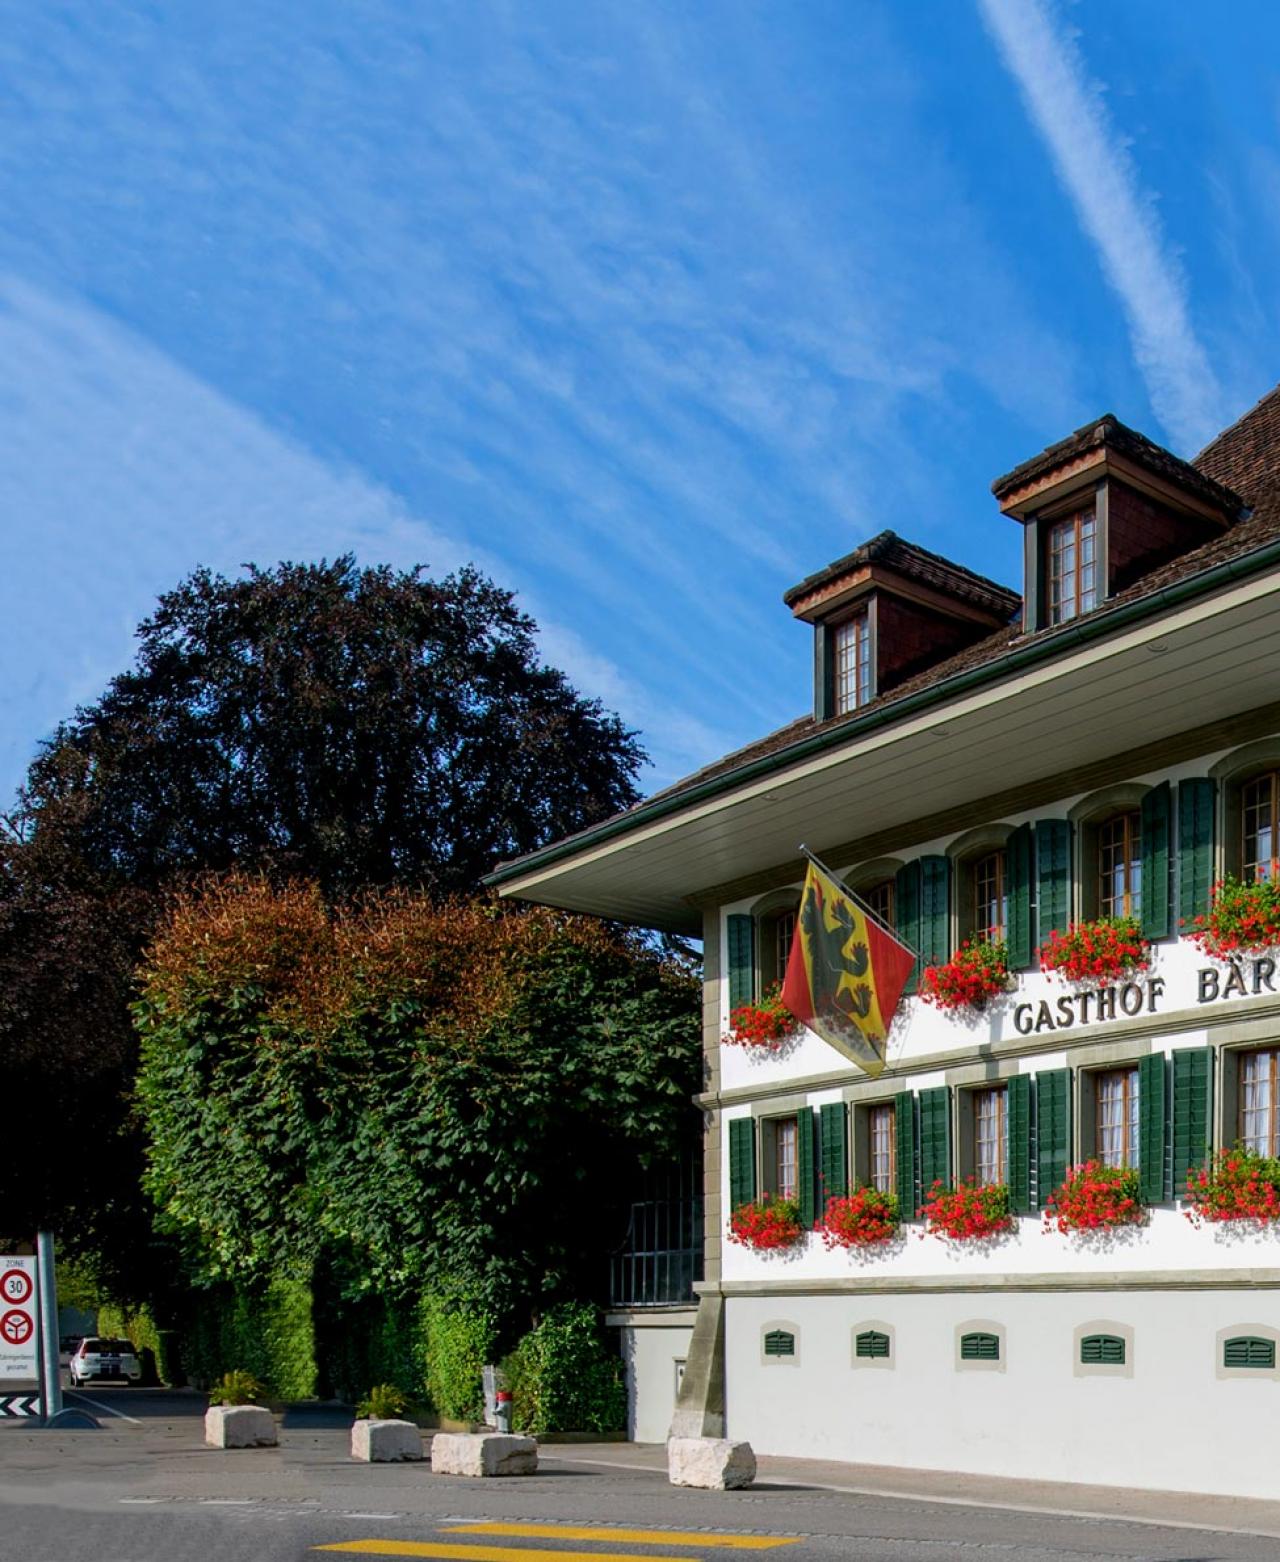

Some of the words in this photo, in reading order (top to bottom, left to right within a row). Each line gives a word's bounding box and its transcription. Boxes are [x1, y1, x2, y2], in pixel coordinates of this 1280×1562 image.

[1014, 977, 1166, 1035] GASTHOF
[6, 1259, 25, 1268] ZONE
[9, 1280, 23, 1294] 30
